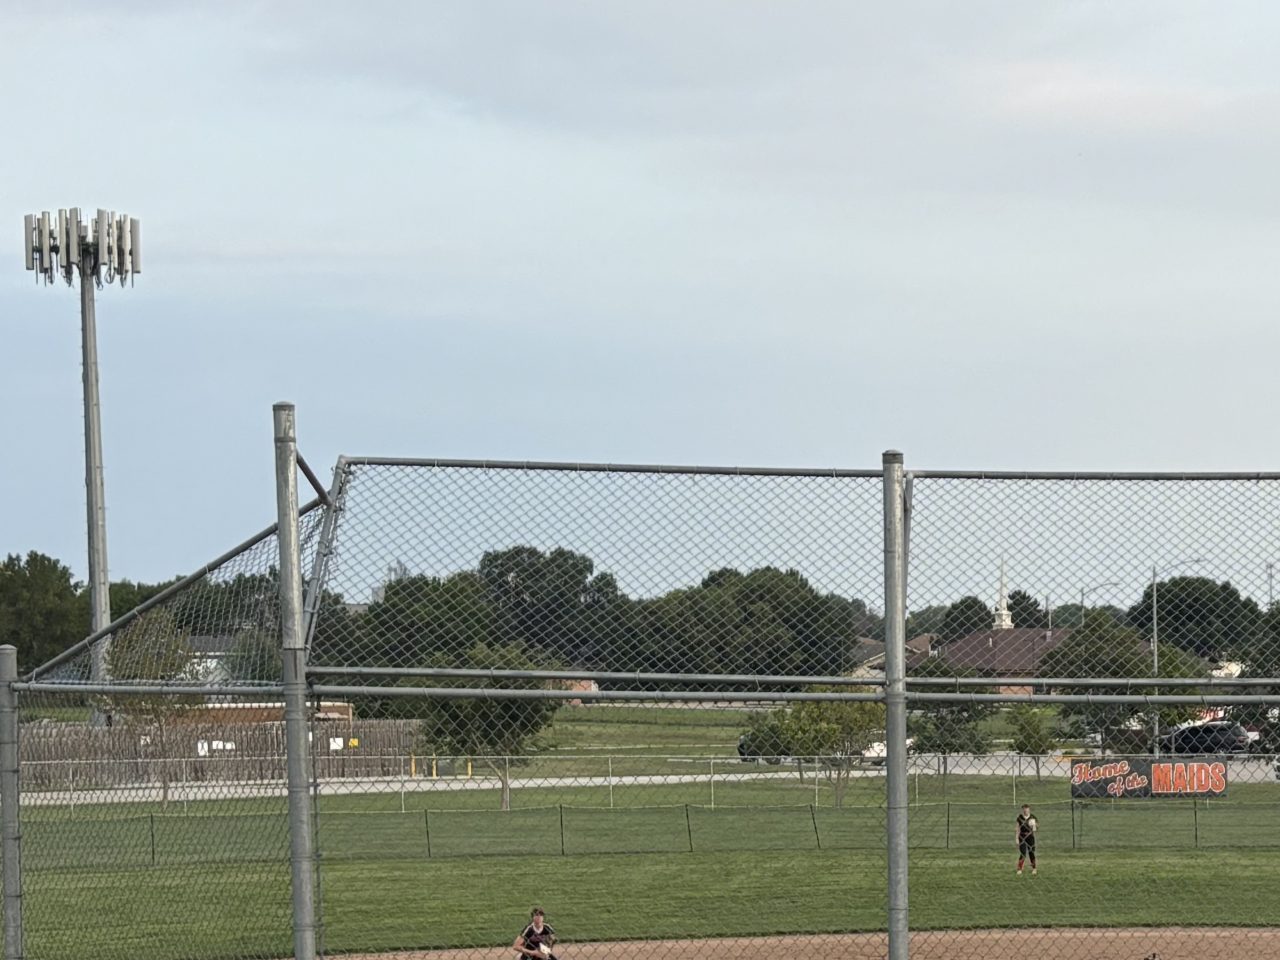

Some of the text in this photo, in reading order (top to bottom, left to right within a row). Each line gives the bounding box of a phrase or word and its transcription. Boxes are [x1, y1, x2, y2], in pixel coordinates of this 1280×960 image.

[1071, 760, 1130, 784] Home
[1107, 772, 1148, 796] of the
[1152, 762, 1226, 793] MAIDS
